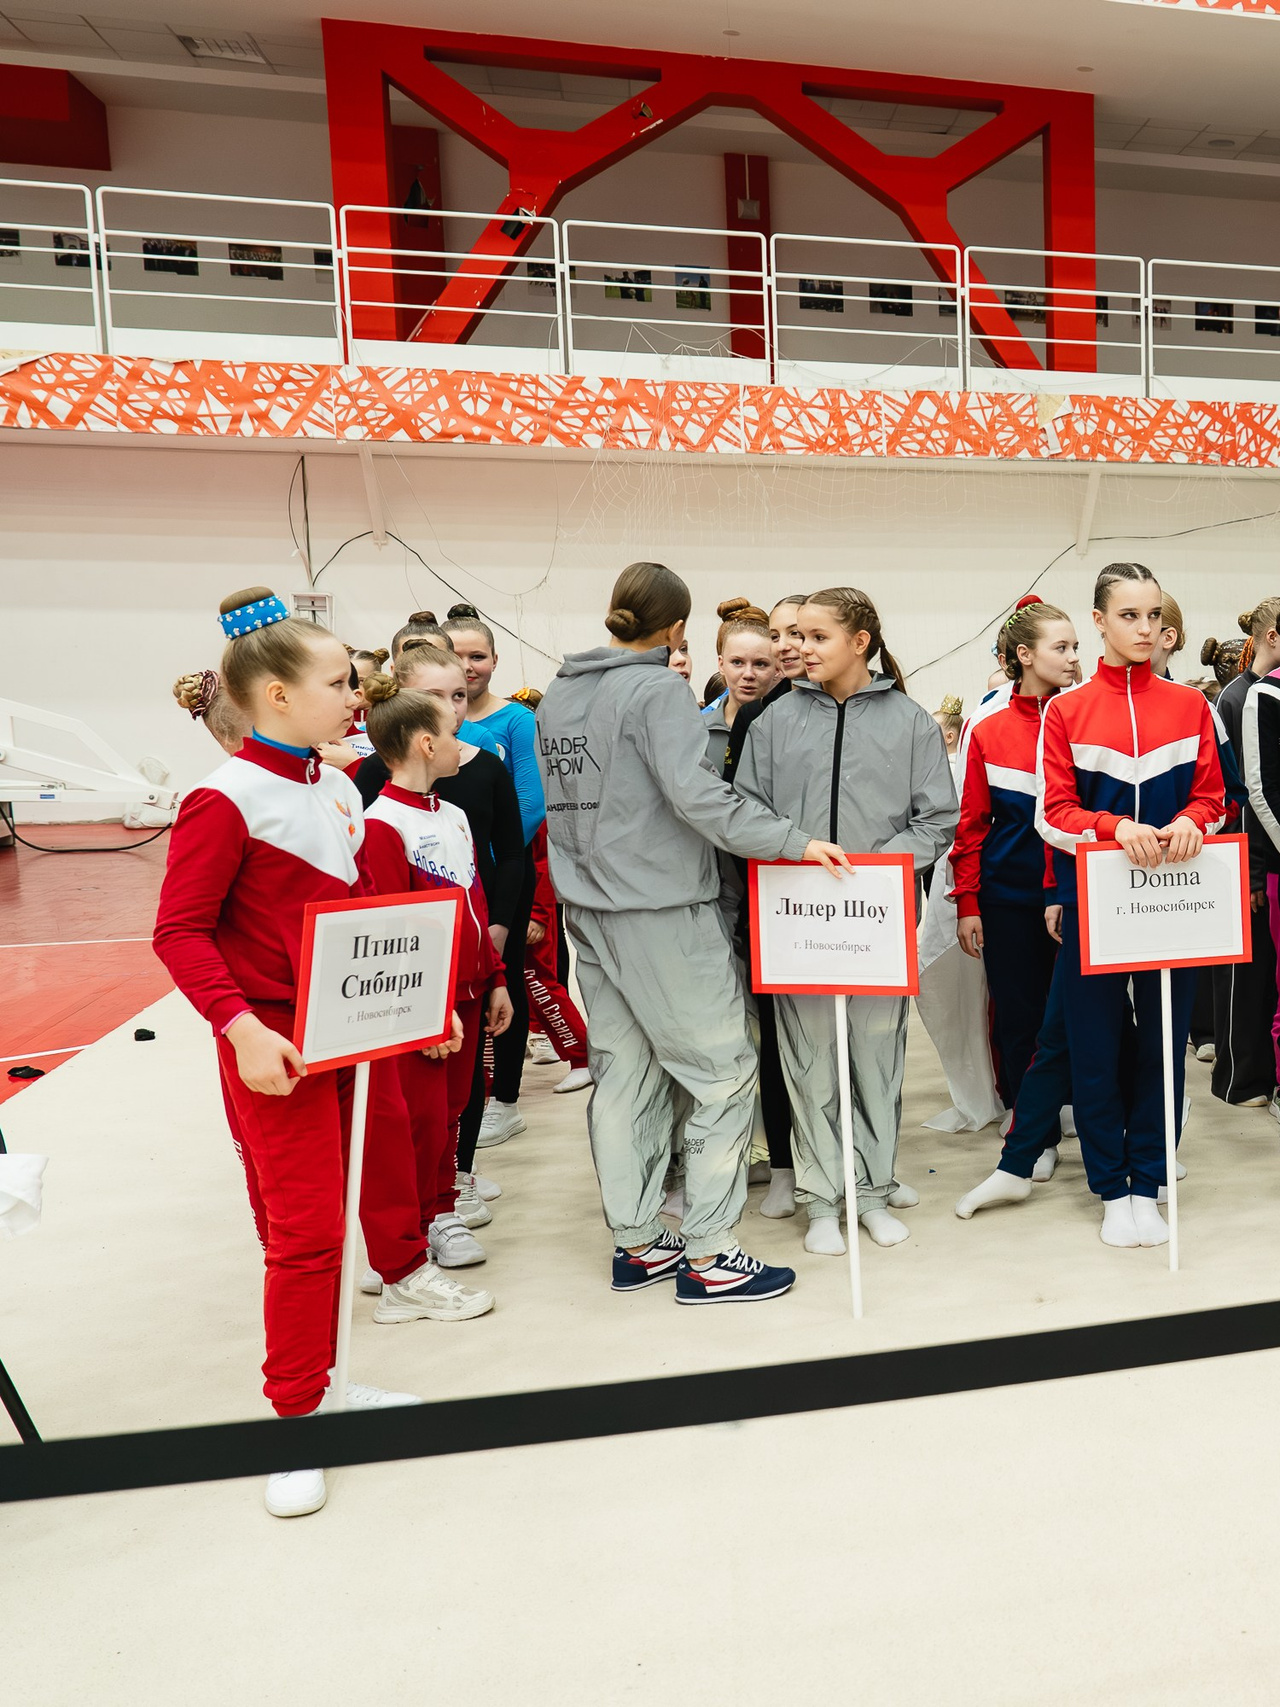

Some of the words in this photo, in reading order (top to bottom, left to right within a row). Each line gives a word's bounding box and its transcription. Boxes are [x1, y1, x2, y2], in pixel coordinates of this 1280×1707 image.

[1128, 868, 1202, 890] Donna
[775, 897, 837, 922] Лидер
[843, 899, 889, 924] Шоу
[1116, 906, 1127, 915] г.
[1130, 899, 1216, 914] Новосибирск
[351, 934, 420, 960] Птица
[804, 939, 872, 954] Новосибирск
[341, 970, 424, 1000] Сибири
[356, 1004, 413, 1023] Новосибирск
[542, 1003, 579, 1048] СИБИРИ
